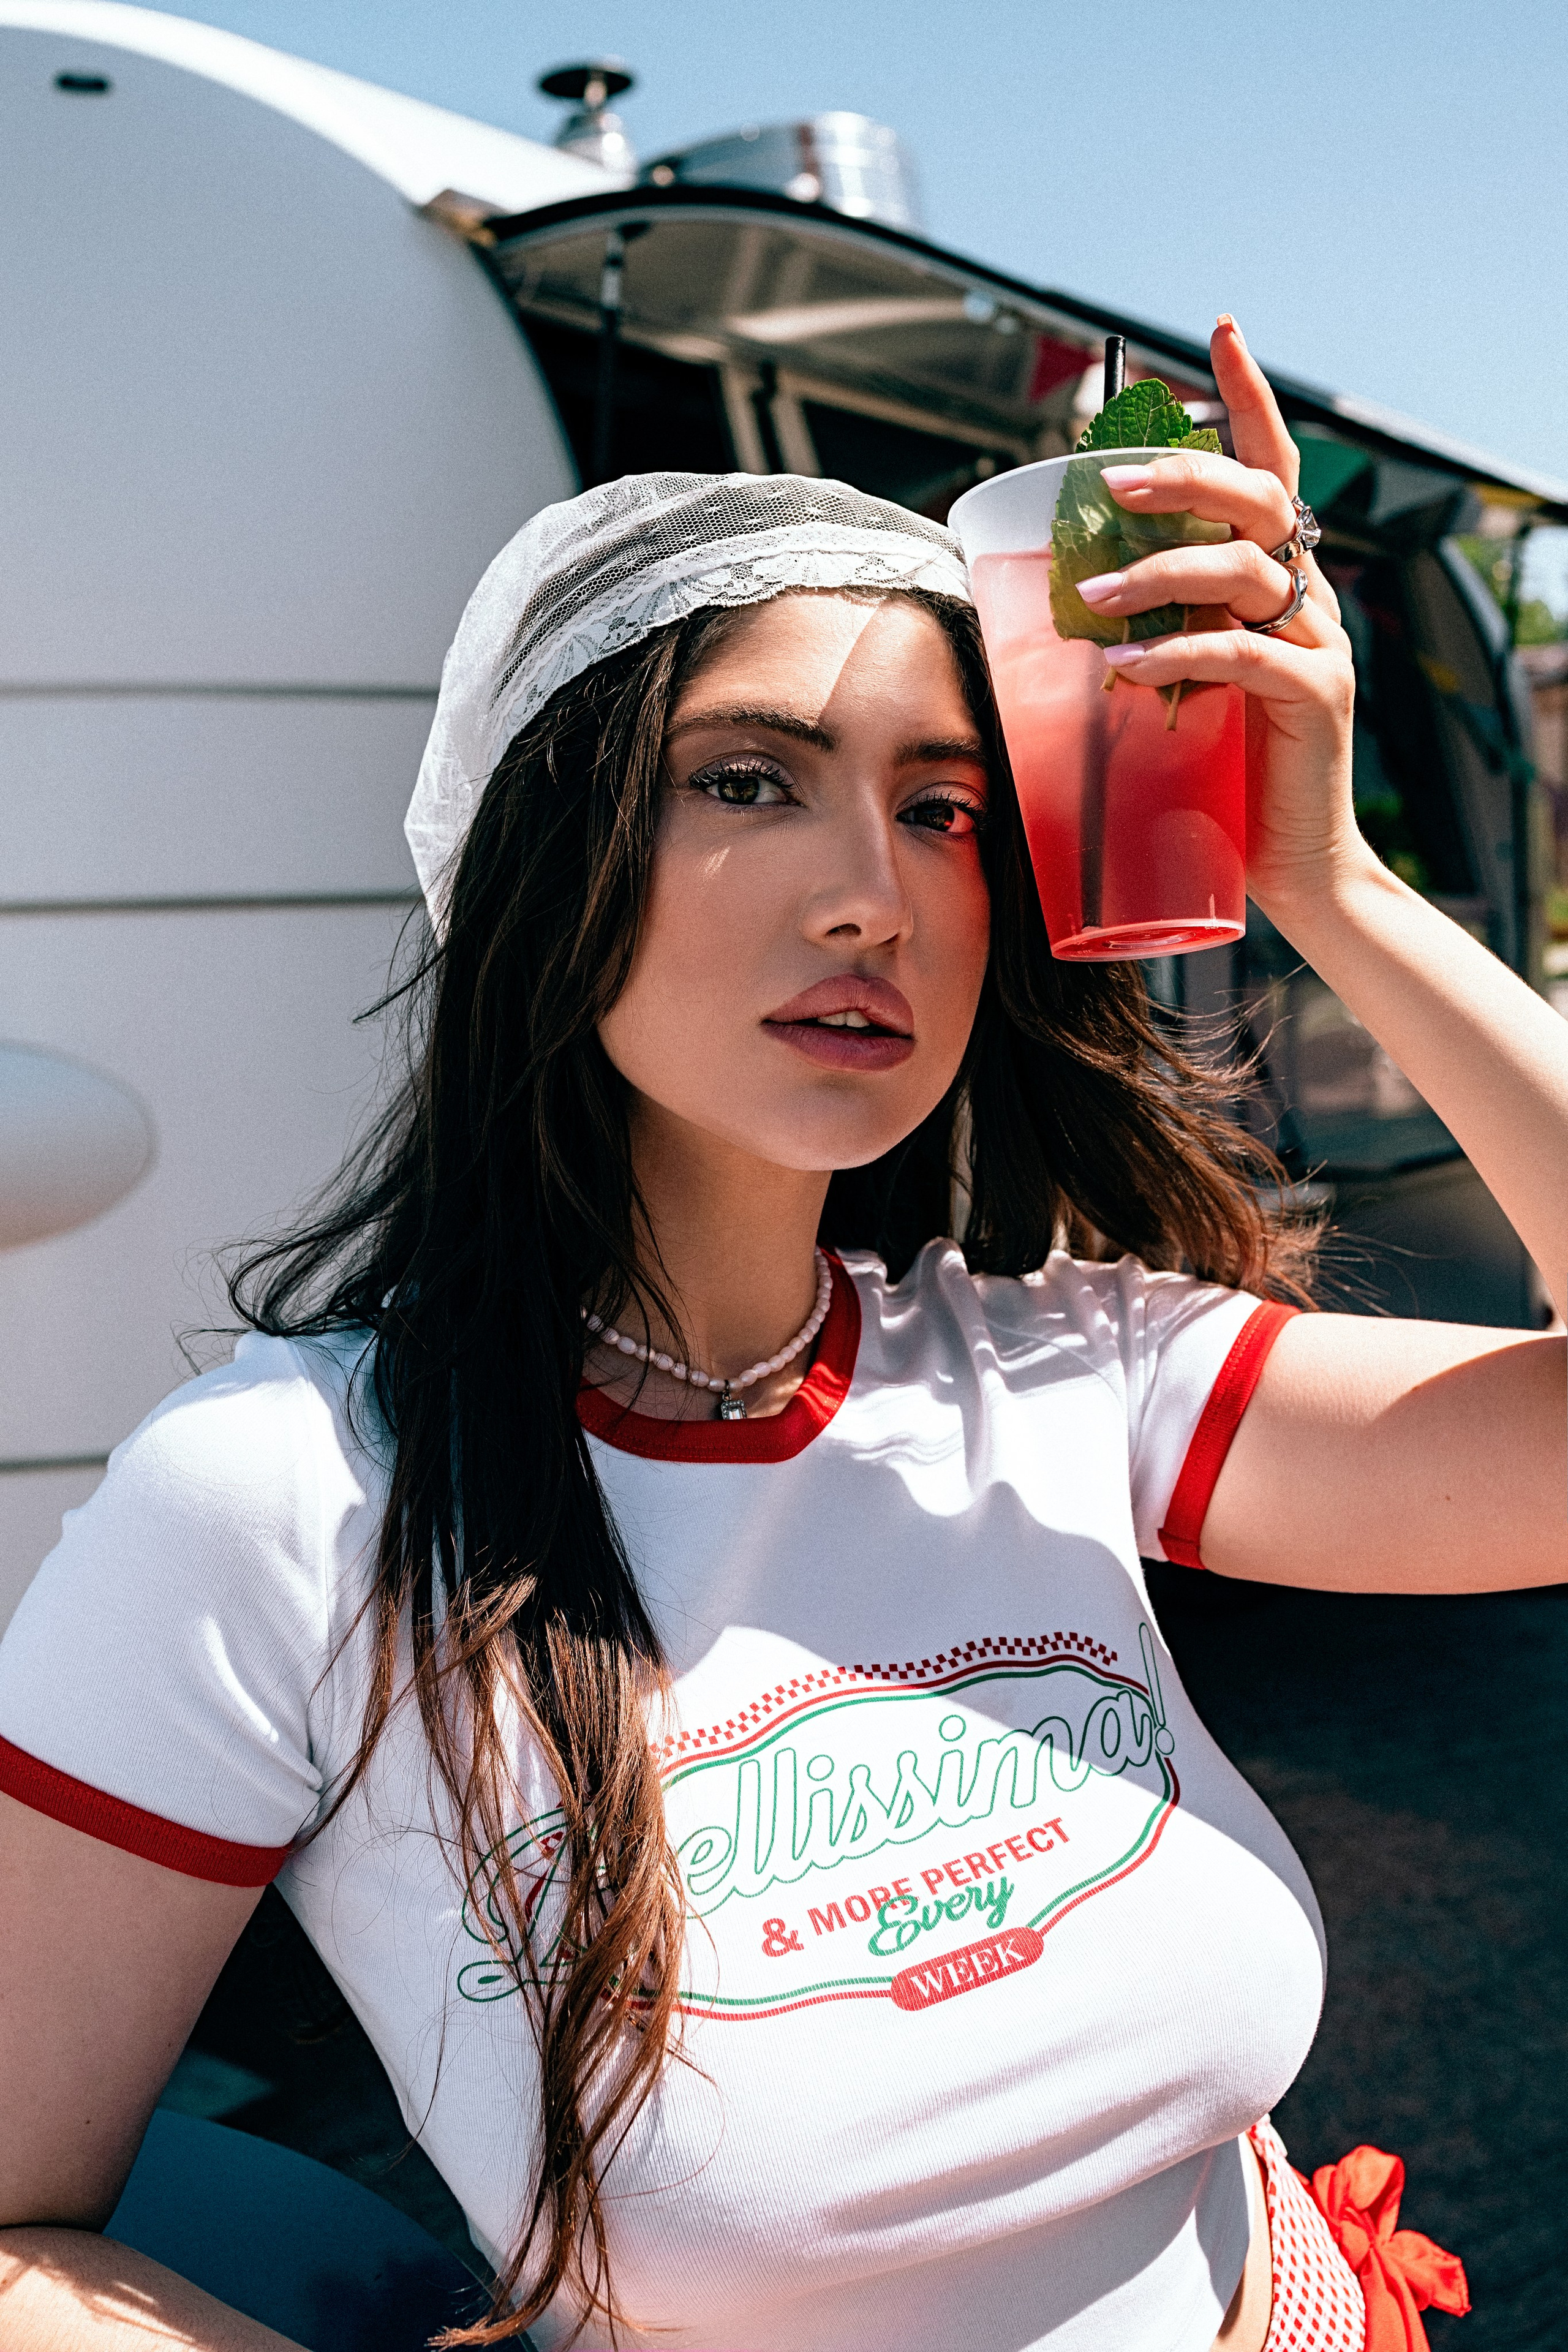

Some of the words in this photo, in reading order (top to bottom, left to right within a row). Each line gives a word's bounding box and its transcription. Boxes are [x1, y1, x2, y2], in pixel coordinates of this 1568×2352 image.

[761, 1918, 804, 1957] &
[807, 1877, 920, 1936] MORE
[919, 1817, 1071, 1895] PERFECT
[867, 1875, 1015, 1956] Every
[909, 1937, 1027, 1999] WEEK
